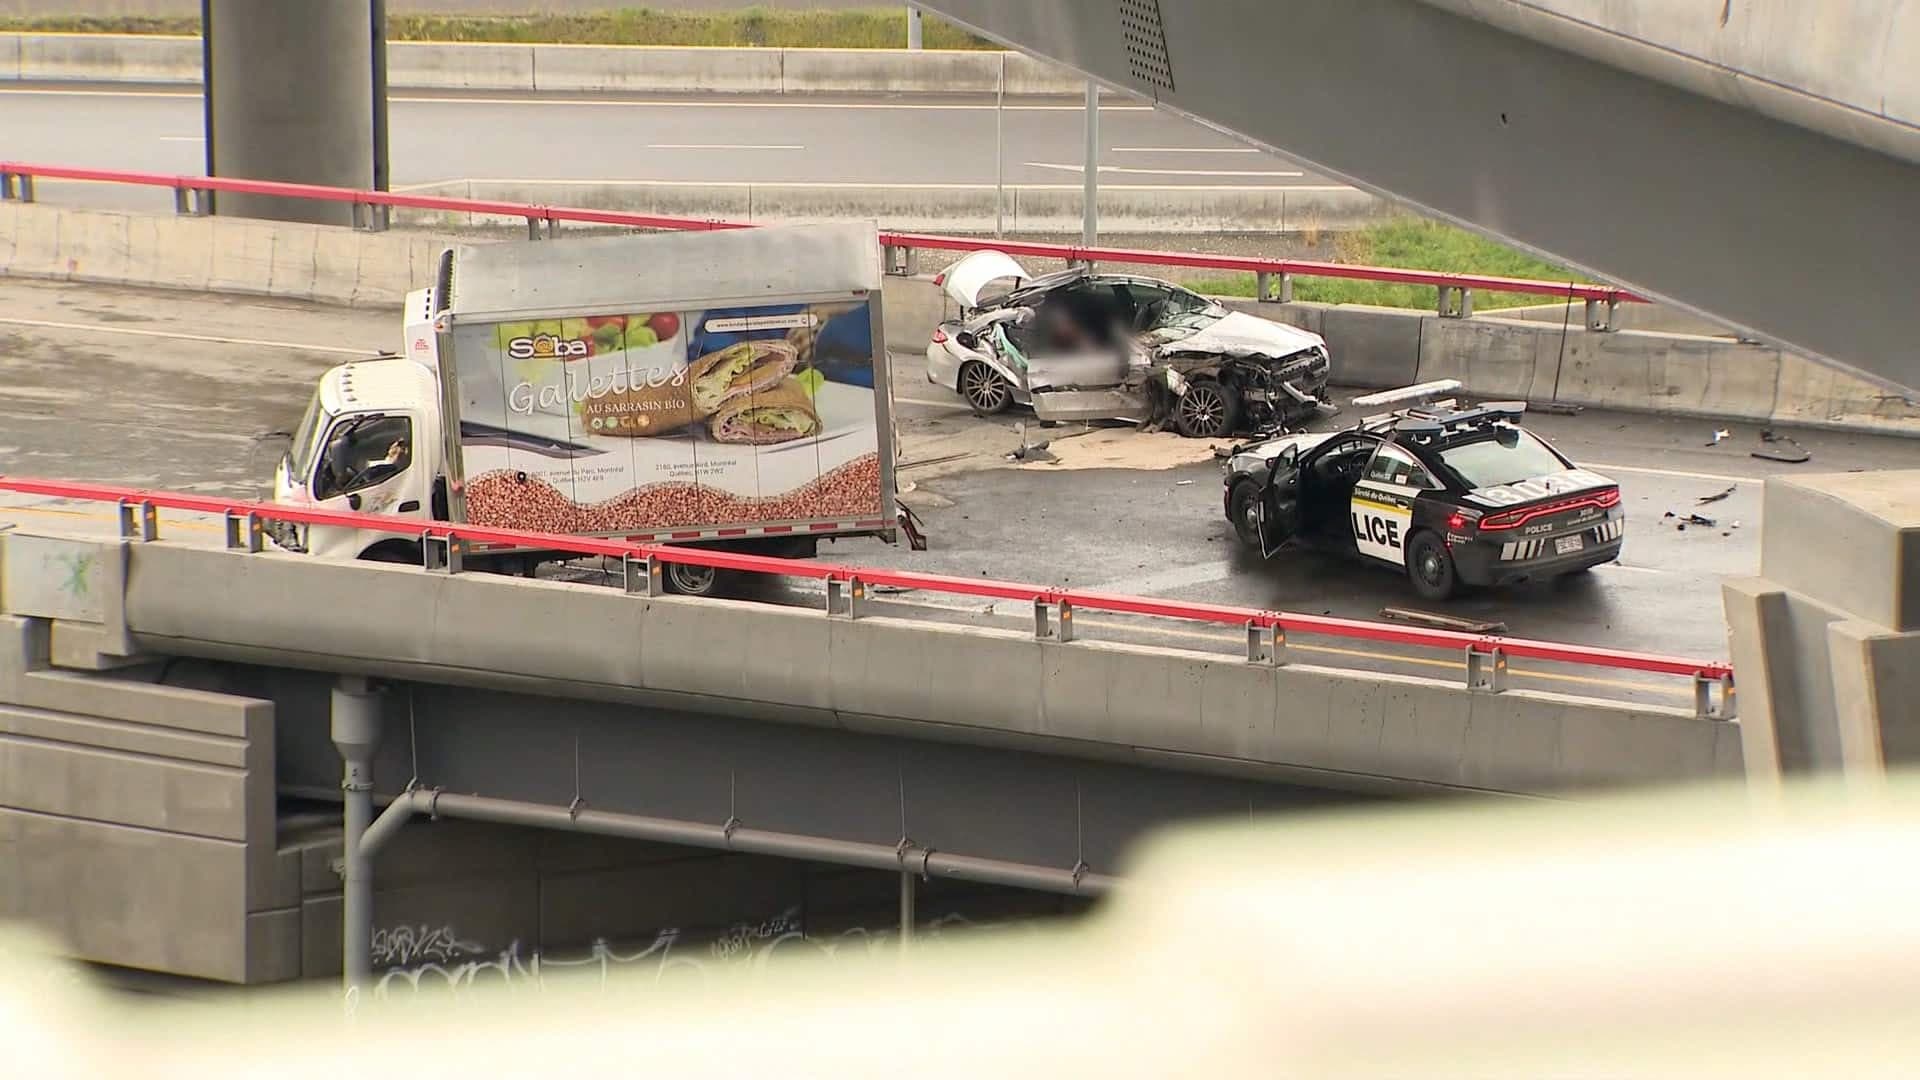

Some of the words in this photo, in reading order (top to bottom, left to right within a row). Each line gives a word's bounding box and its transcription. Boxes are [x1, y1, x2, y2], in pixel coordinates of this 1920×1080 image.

[508, 333, 588, 359] Soba
[508, 360, 690, 416] Galettes
[586, 403, 602, 414] AU
[604, 400, 662, 413] SARRASIN
[665, 399, 686, 410] BIO
[1352, 512, 1401, 548] LICE
[1525, 523, 1553, 535] POLICE
